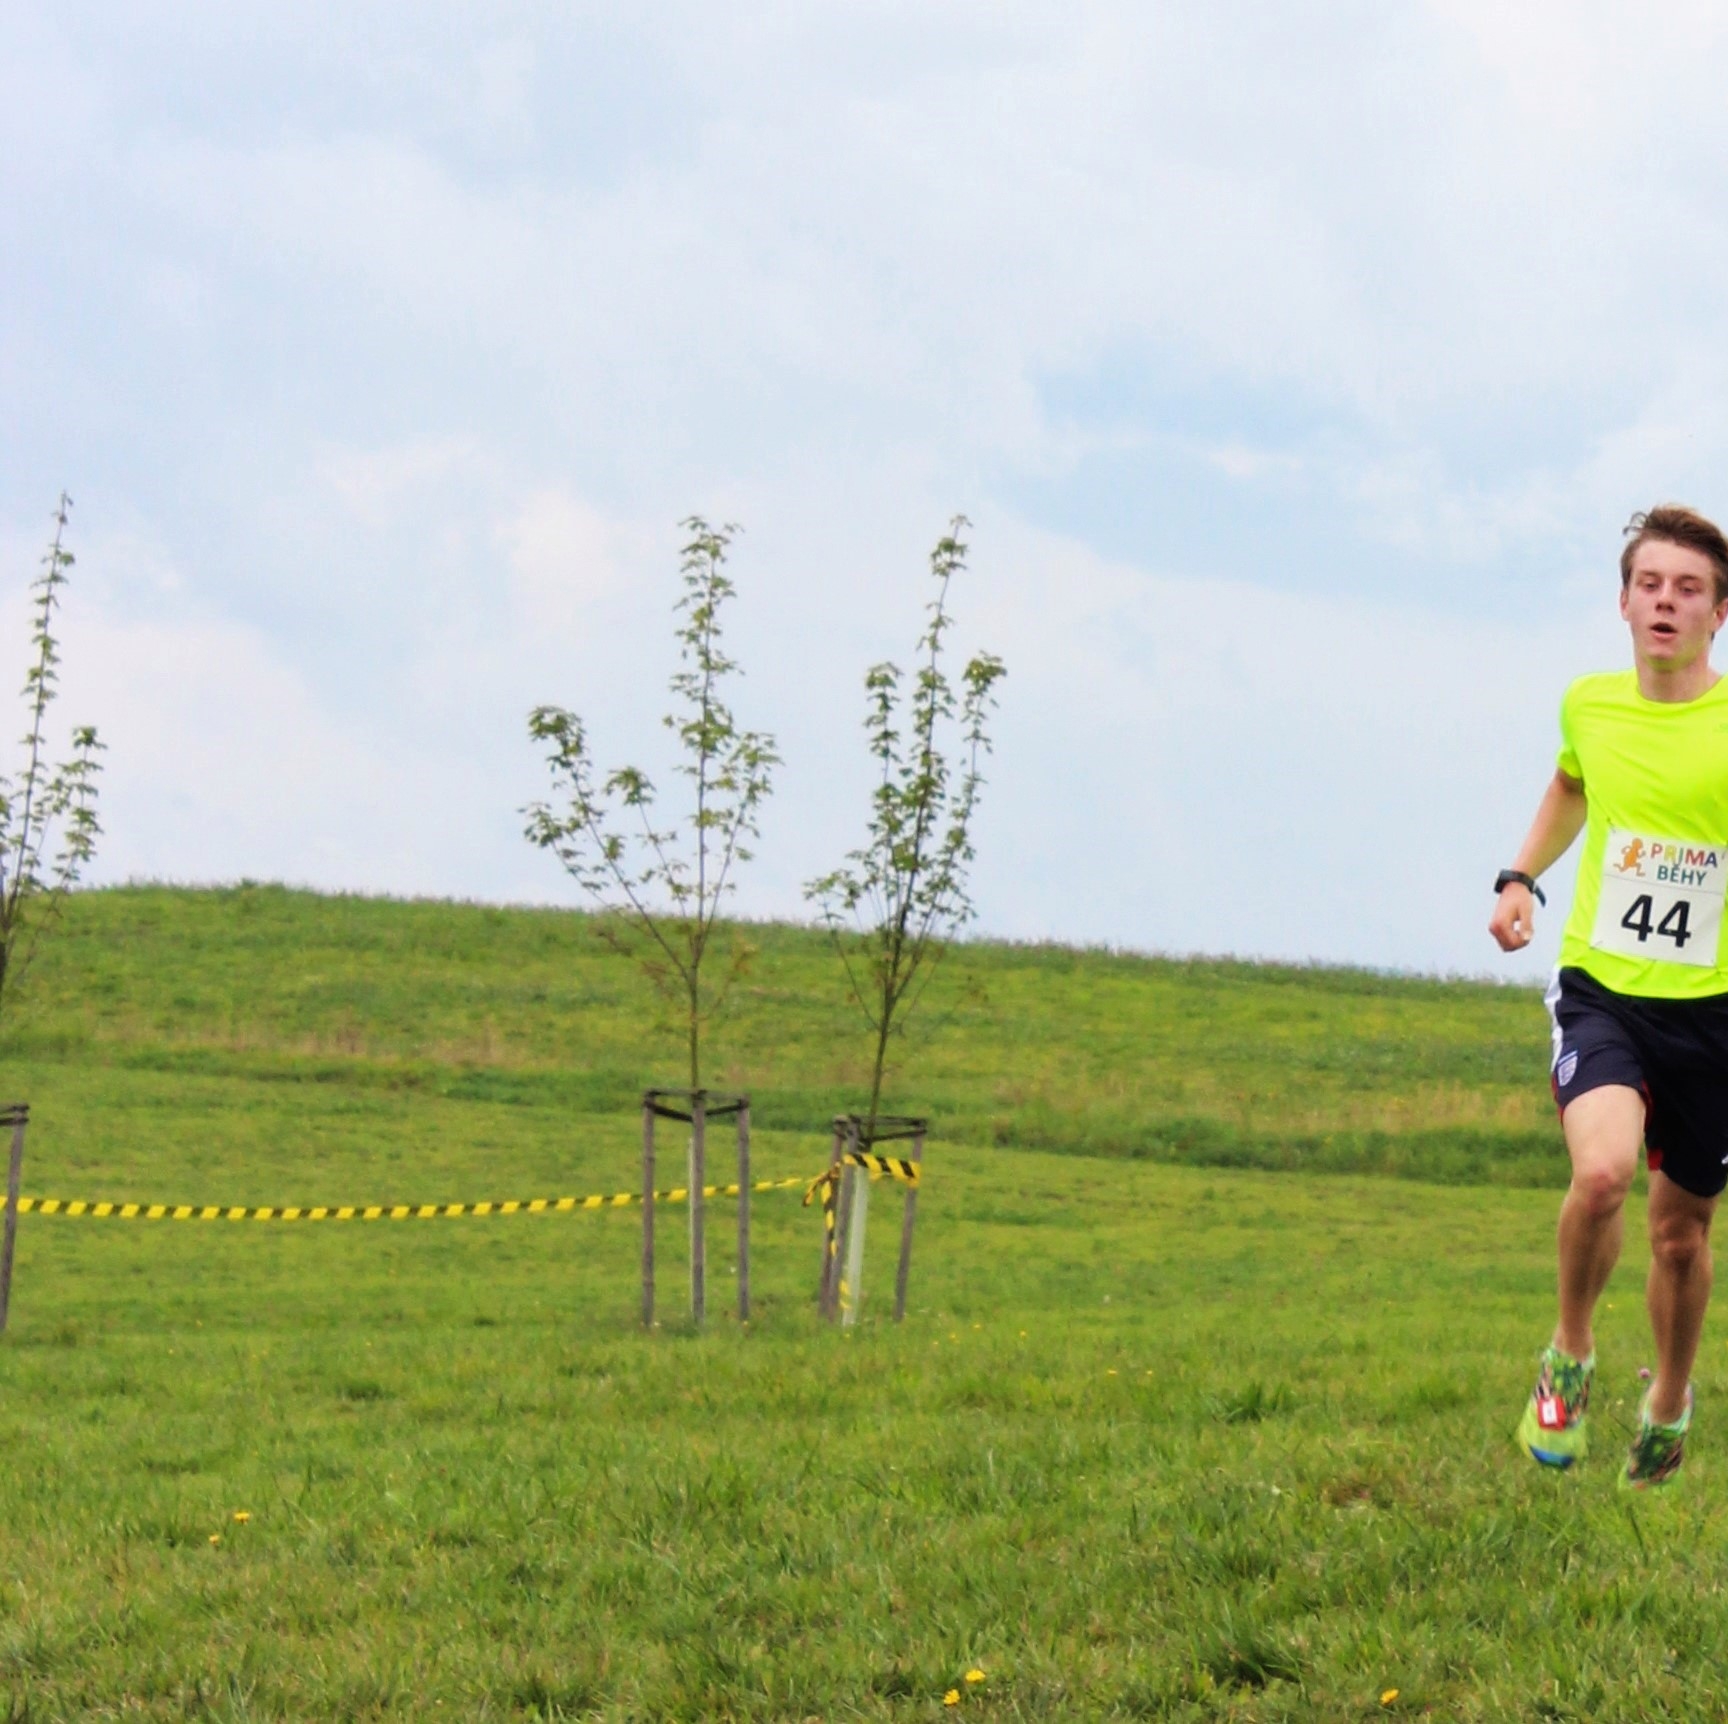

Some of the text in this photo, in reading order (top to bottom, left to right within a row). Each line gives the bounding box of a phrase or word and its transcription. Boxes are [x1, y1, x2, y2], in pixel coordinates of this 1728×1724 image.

[1651, 843, 1718, 868] PRIMA
[1657, 863, 1707, 886] BĚHY
[1621, 894, 1692, 948] 44
